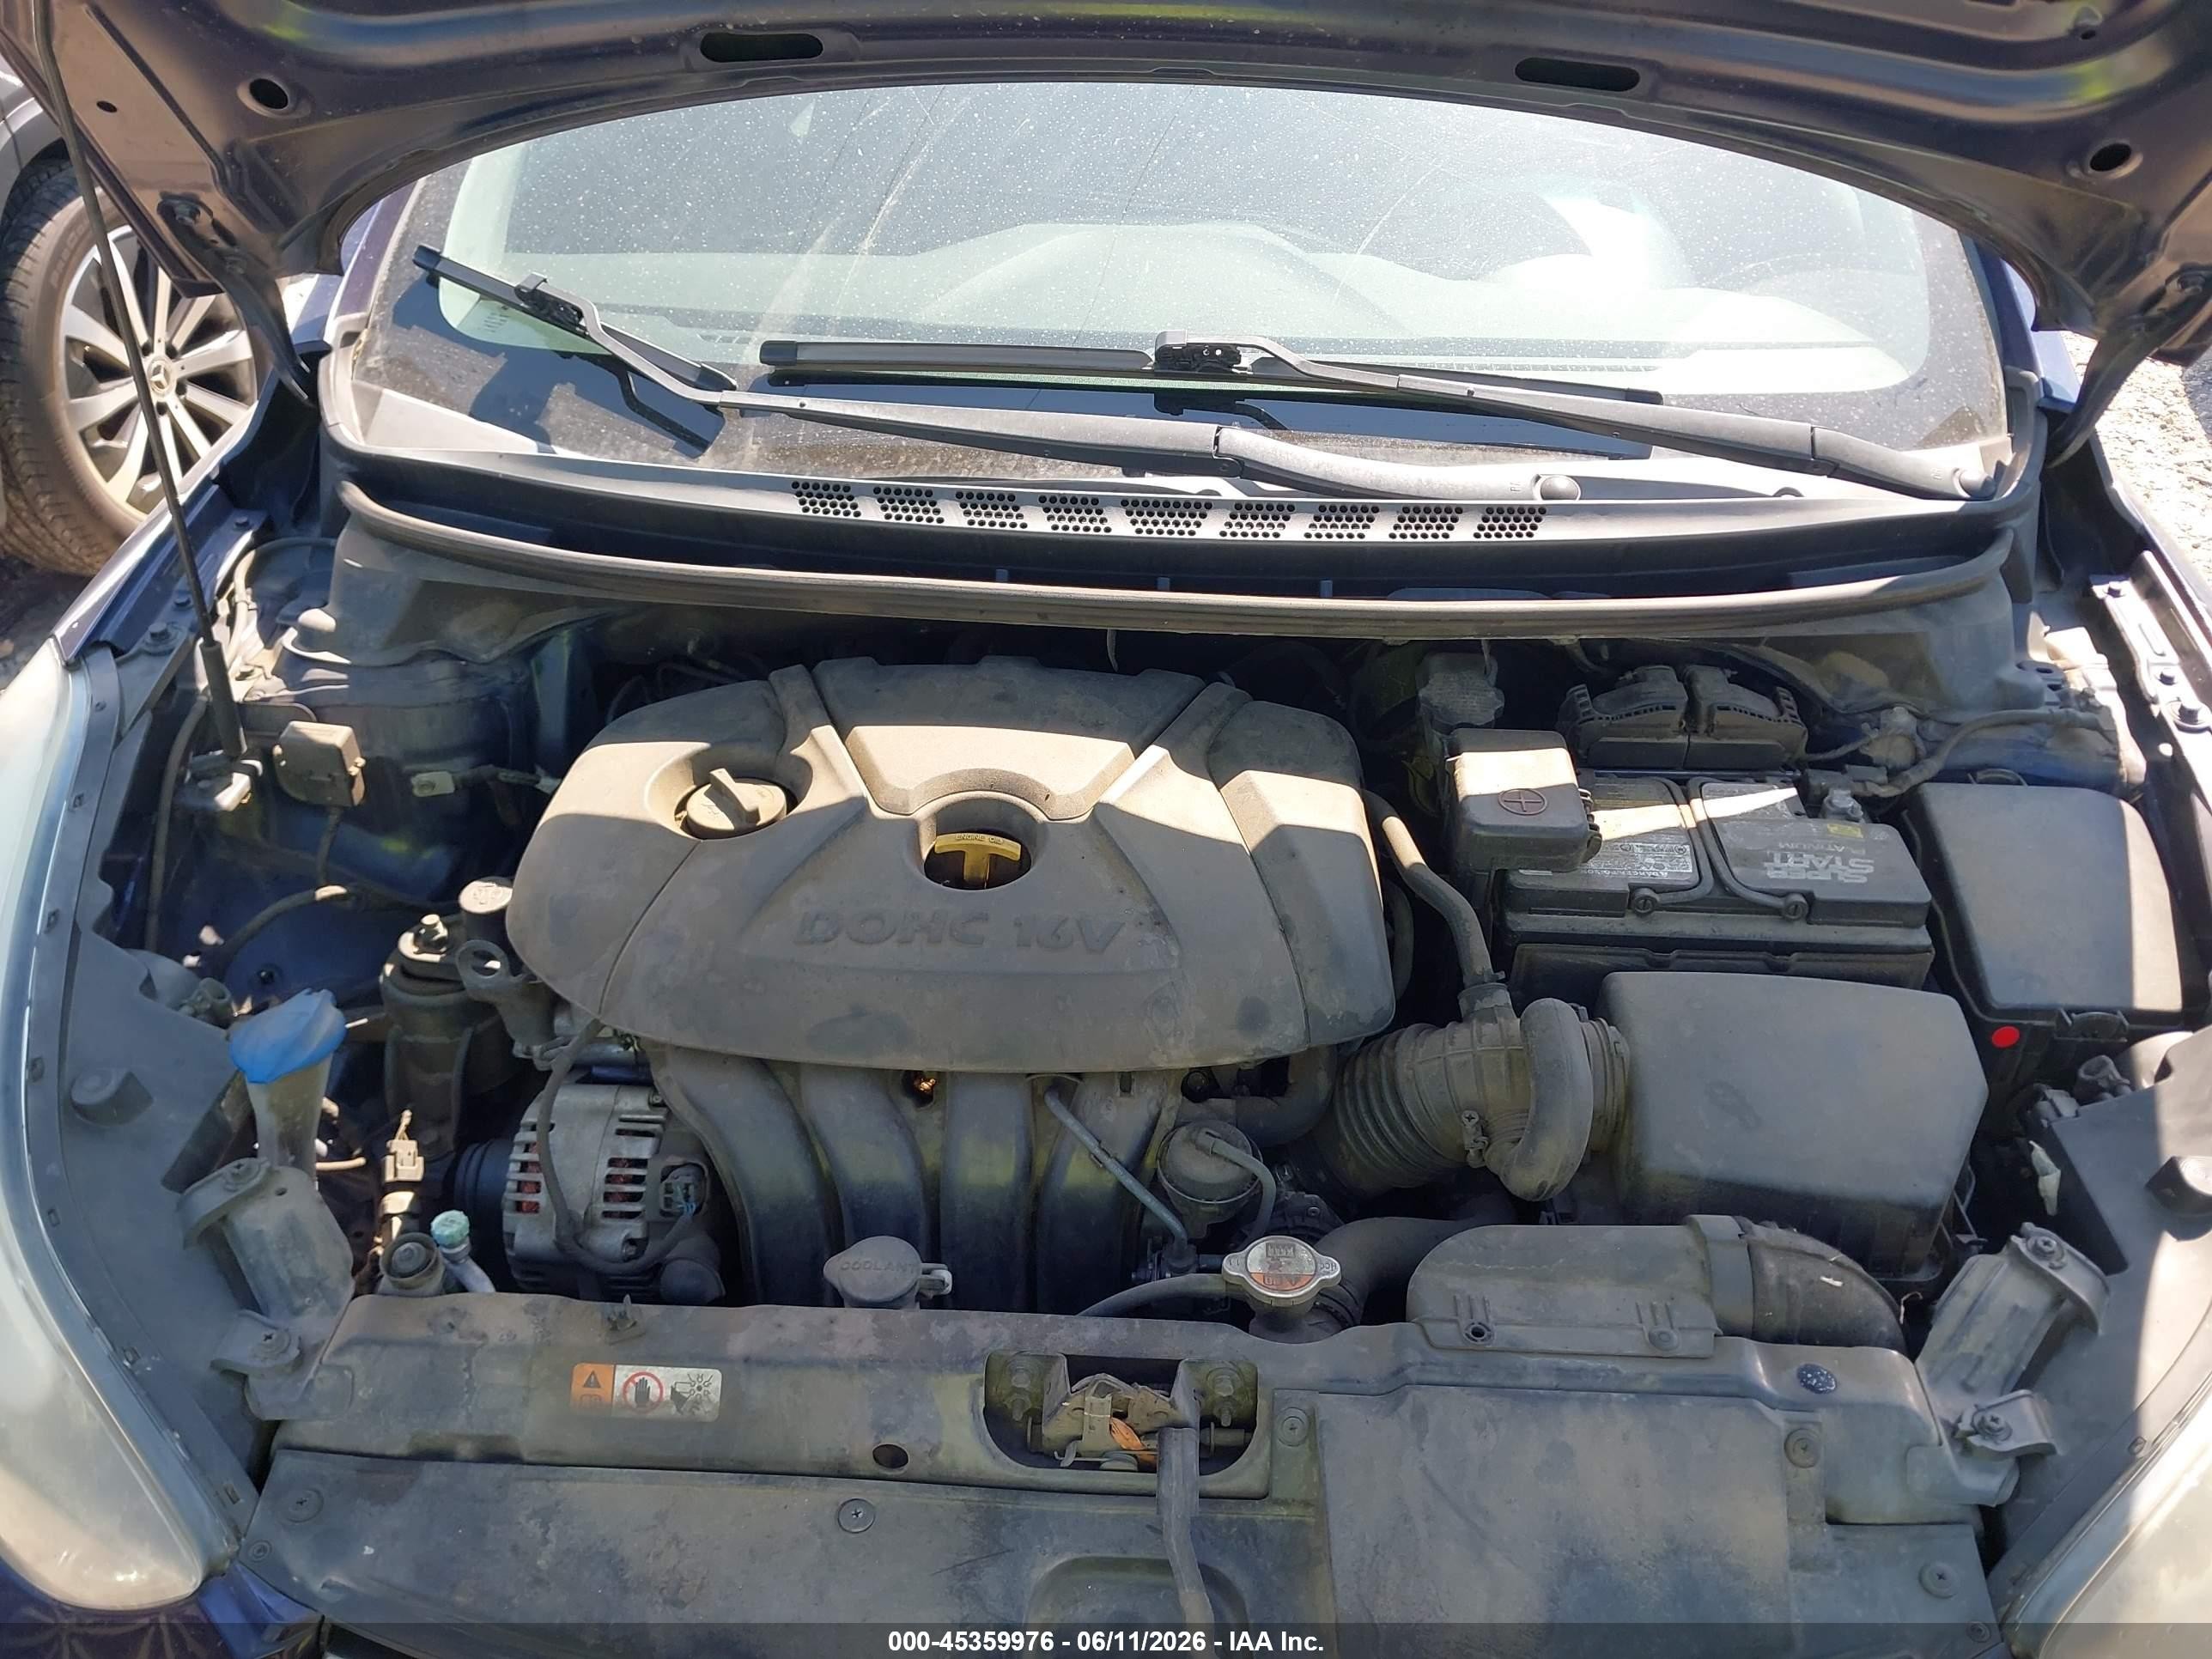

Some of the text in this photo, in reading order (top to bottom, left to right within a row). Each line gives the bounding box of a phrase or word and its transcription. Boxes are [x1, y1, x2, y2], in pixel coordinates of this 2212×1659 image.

[1779, 842, 1866, 855] PATINUM
[1764, 852, 1874, 874] START
[1766, 866, 1868, 883] SUPER
[793, 910, 1126, 955] DOHC 16V
[841, 1260, 915, 1274] COOLANT
